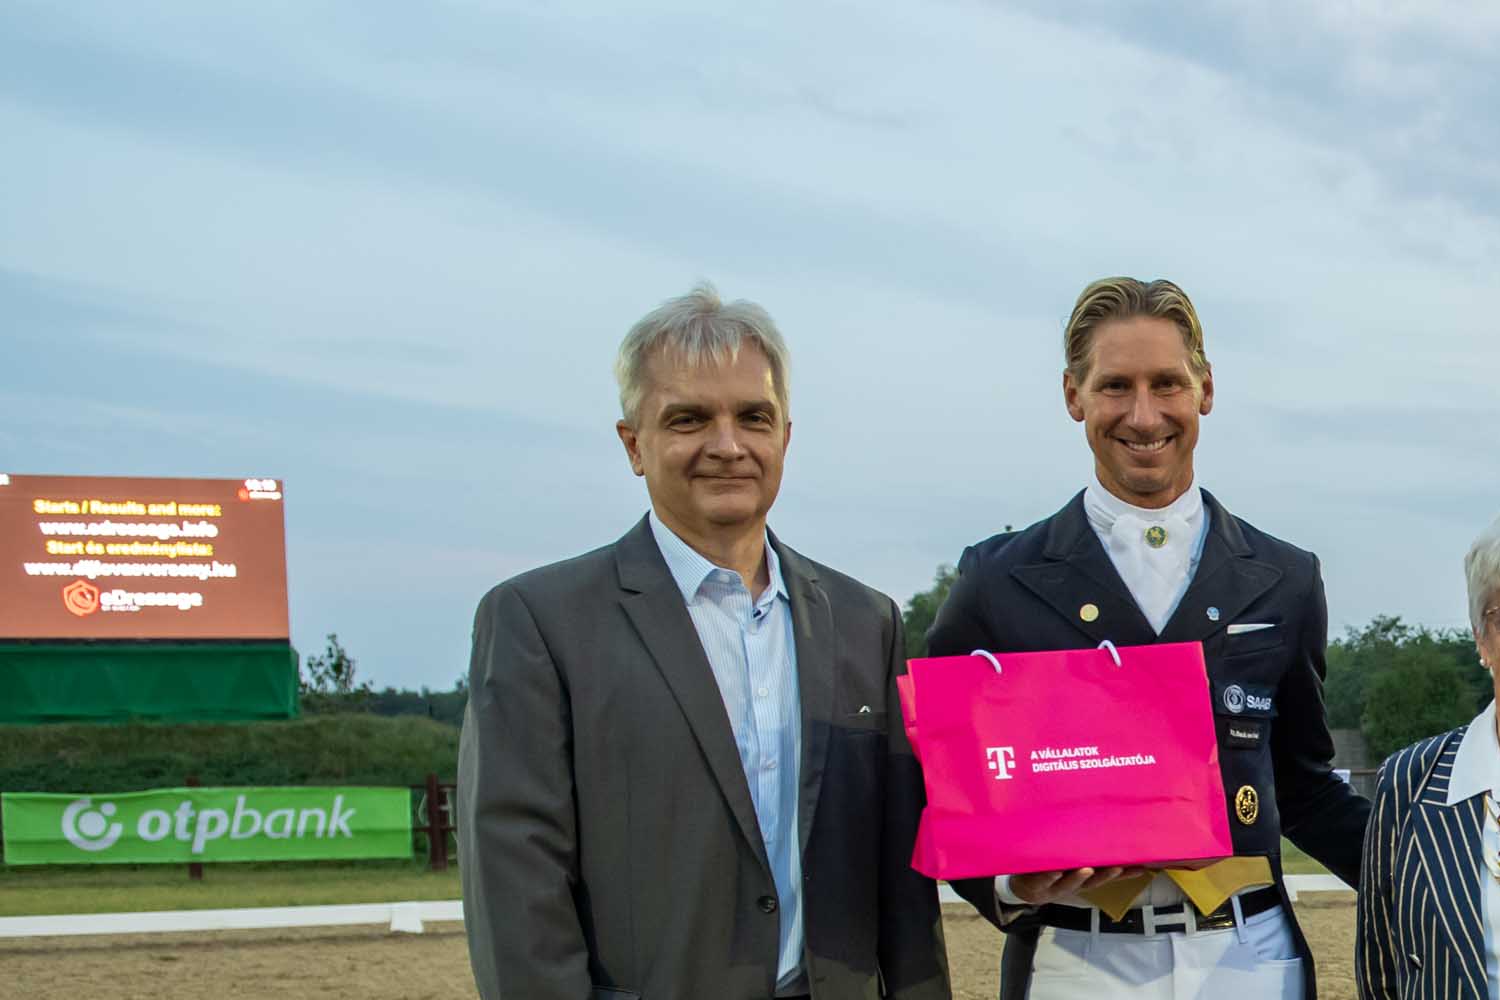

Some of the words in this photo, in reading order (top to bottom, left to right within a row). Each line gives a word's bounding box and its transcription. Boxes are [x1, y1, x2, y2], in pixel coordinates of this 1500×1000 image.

[33, 499, 80, 514] Starts
[90, 500, 146, 516] Results
[148, 502, 177, 516] and
[178, 503, 222, 517] more:
[46, 540, 85, 555] Start
[100, 589, 203, 610] eDressage
[1246, 694, 1272, 710] SAAB
[1030, 750, 1039, 760] A
[1038, 746, 1099, 760] VÁLLALATOK
[1032, 759, 1079, 773] DIGITÁLIS
[1079, 754, 1156, 770] SZOLGÁLTATÓJA
[136, 795, 356, 854] otpbank
